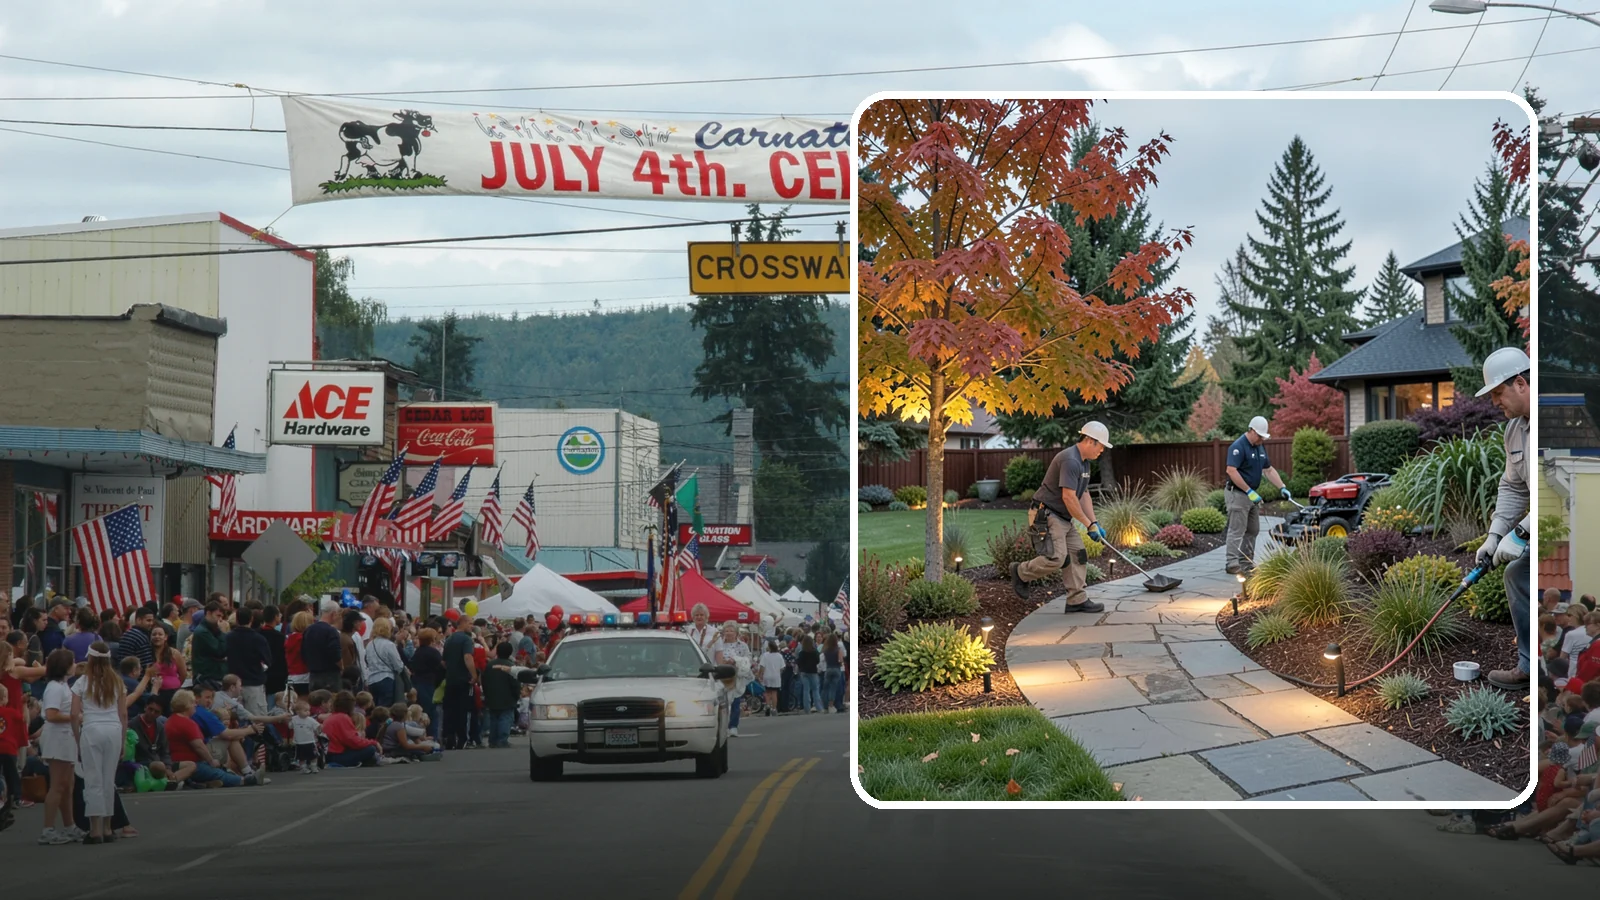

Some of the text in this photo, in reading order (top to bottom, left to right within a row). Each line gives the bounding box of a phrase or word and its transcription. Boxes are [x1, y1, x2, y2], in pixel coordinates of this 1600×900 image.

[695, 121, 850, 150] Carnat
[481, 140, 605, 193] JULY
[632, 149, 746, 198] 4th.
[696, 254, 850, 280] CROSSWA
[282, 379, 374, 420] ACE
[405, 408, 453, 422] CEDAR
[283, 420, 371, 437] Hardware
[416, 428, 477, 447] Coca-Cola
[95, 484, 125, 495] Vincent
[126, 485, 136, 495] de
[137, 485, 155, 495] Paul
[688, 526, 742, 535] CRNATION
[699, 535, 730, 543] GLASS
